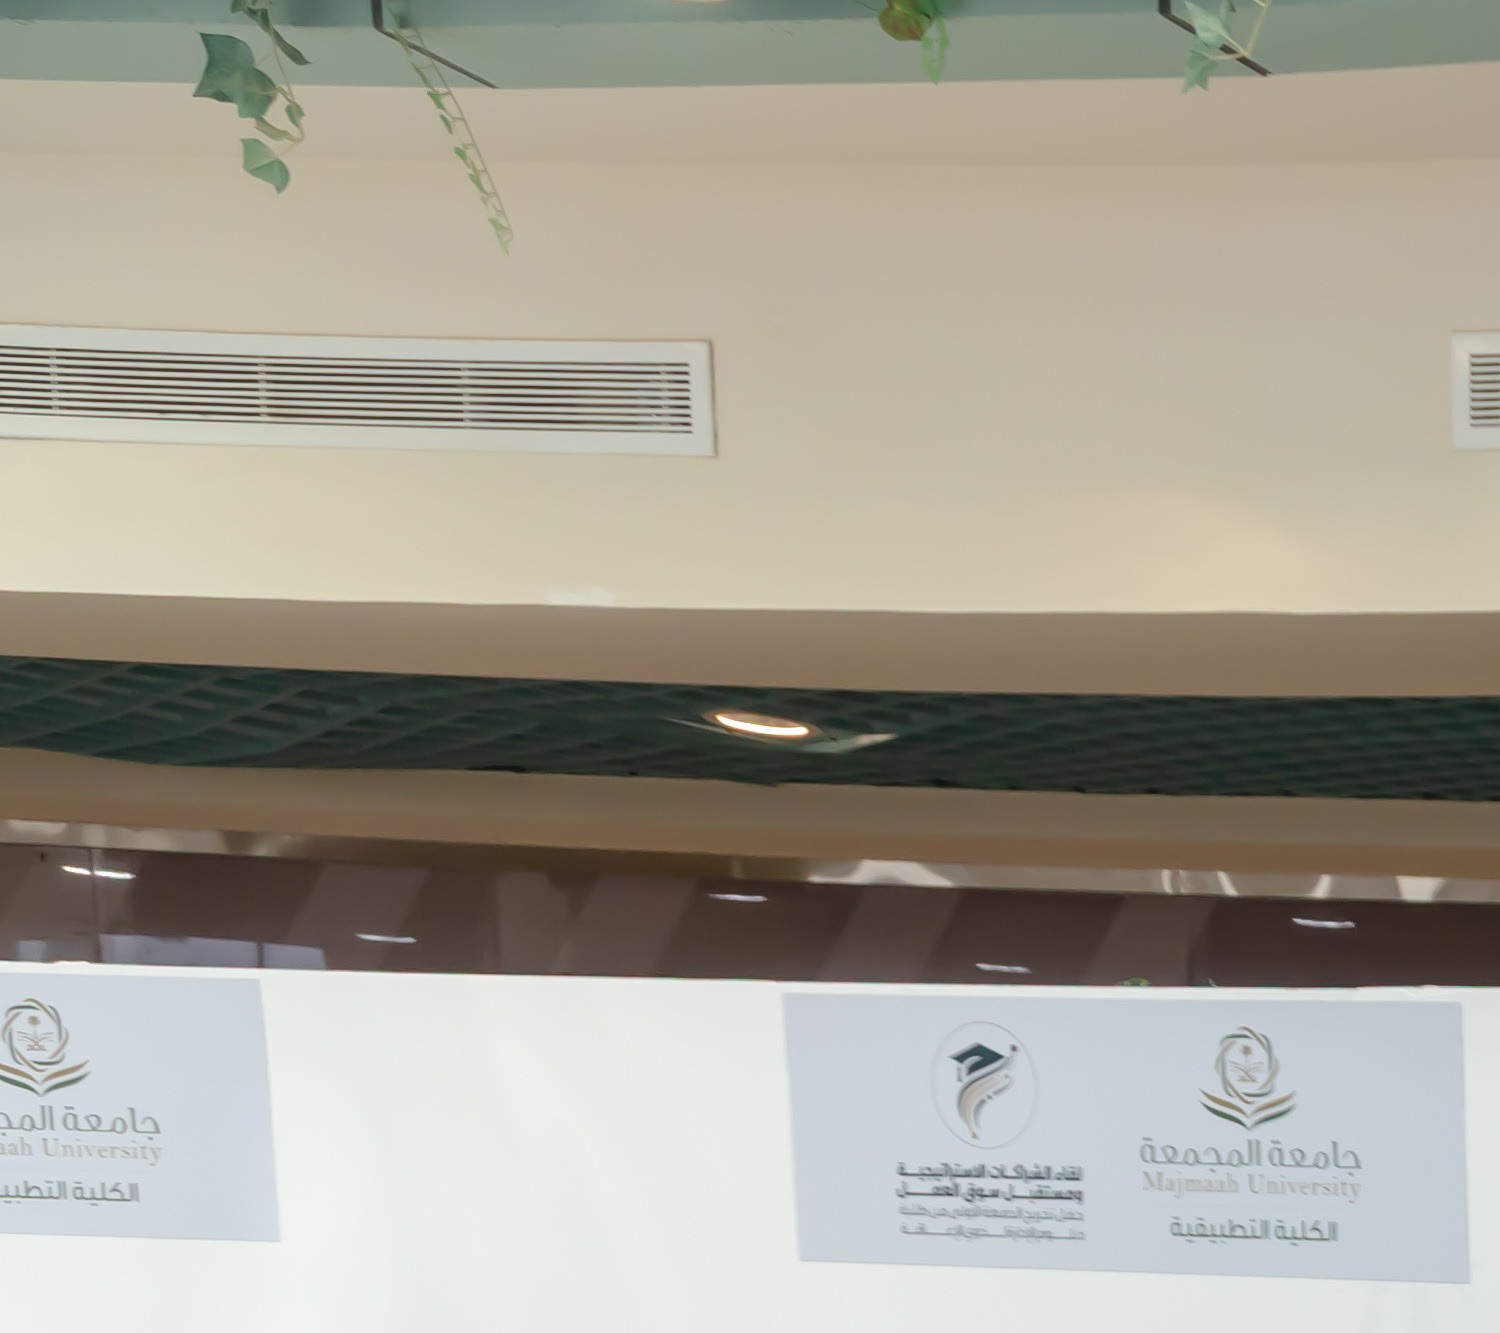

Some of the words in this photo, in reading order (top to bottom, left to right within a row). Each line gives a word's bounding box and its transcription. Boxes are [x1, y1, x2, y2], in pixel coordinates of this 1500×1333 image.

[0, 1104, 56, 1138] المج
[62, 1105, 162, 1142] جامعة
[41, 1137, 162, 1168] University
[1138, 1136, 1264, 1175] المجمعة
[1266, 1139, 1363, 1178] جامعة
[0, 1179, 69, 1205] التطبي
[72, 1180, 141, 1208] الكلية
[1141, 1169, 1240, 1200] Majmaah
[1247, 1172, 1362, 1205] University
[1168, 1215, 1272, 1245] التطبيقية
[1273, 1218, 1340, 1247] الكلية
